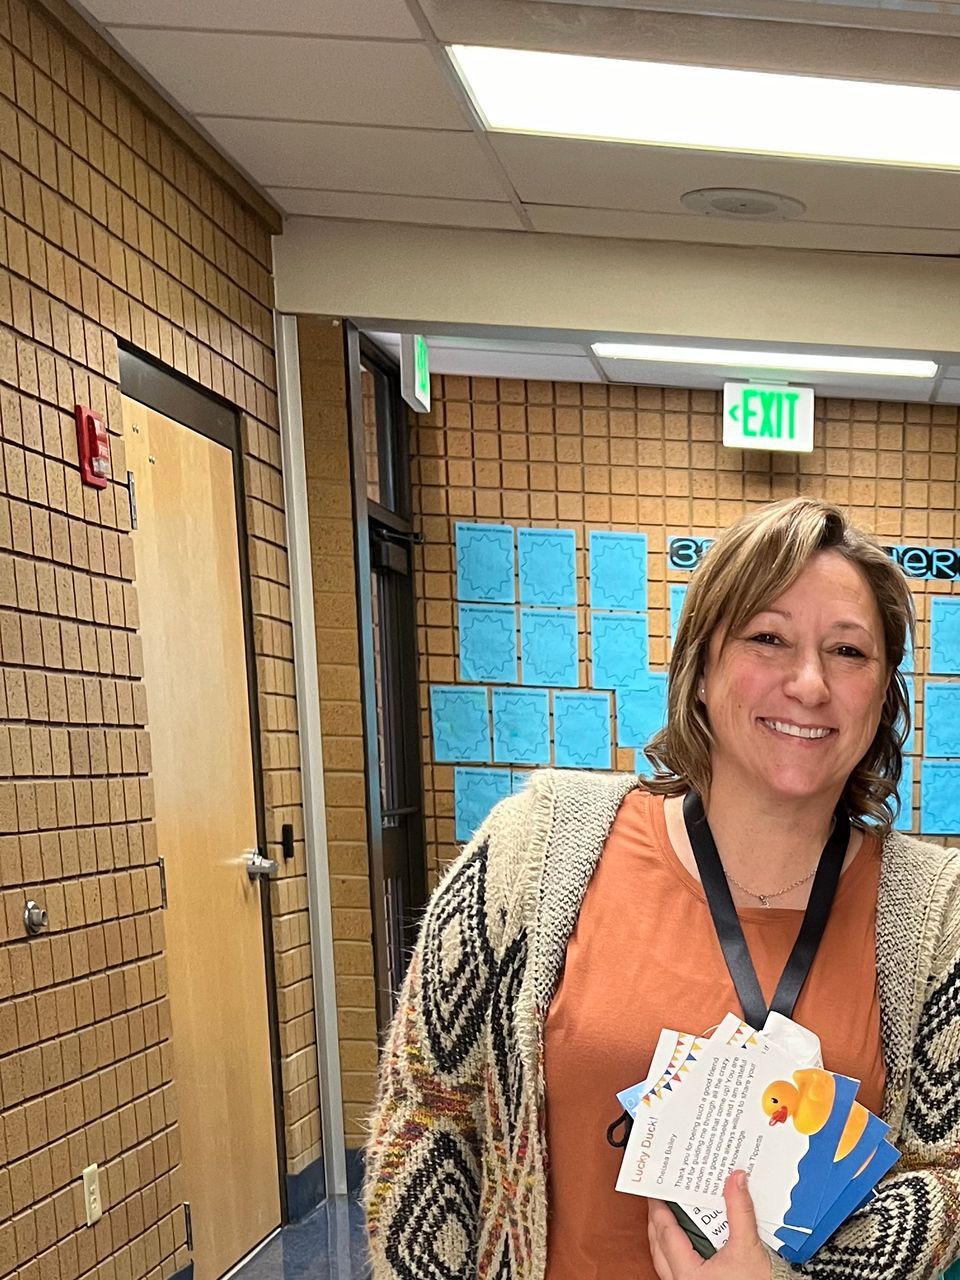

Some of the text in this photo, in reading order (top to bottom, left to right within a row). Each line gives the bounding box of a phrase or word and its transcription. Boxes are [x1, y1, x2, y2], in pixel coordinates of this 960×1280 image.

[743, 390, 799, 439] EXIT
[714, 1078, 723, 1089] the
[719, 1058, 730, 1077] crazy
[674, 1168, 686, 1187] Thank
[690, 1122, 701, 1141] being
[696, 1104, 705, 1120] such
[704, 1078, 712, 1096] good
[708, 1057, 719, 1077] friend
[694, 1167, 705, 1192] random
[702, 1133, 716, 1165] situations
[712, 1118, 720, 1132] that
[717, 1098, 726, 1117] come
[725, 1070, 735, 1083] You
[700, 1128, 708, 1139] me
[703, 1100, 716, 1126] through
[703, 1178, 711, 1194] such
[710, 1153, 719, 1170] good
[716, 1119, 729, 1151] counselor
[726, 1104, 734, 1117] and
[731, 1087, 739, 1099] am
[736, 1060, 747, 1086] grateful
[632, 1116, 658, 1182] Lucky Duck!
[692, 1140, 705, 1165] guiding
[711, 1182, 719, 1195] that
[725, 1132, 735, 1154] always
[732, 1109, 743, 1130] willing
[741, 1080, 751, 1099] share
[730, 1131, 745, 1166] knowledge
[749, 1135, 763, 1160] Tippetts
[657, 1134, 677, 1184] Chelsea Bailey
